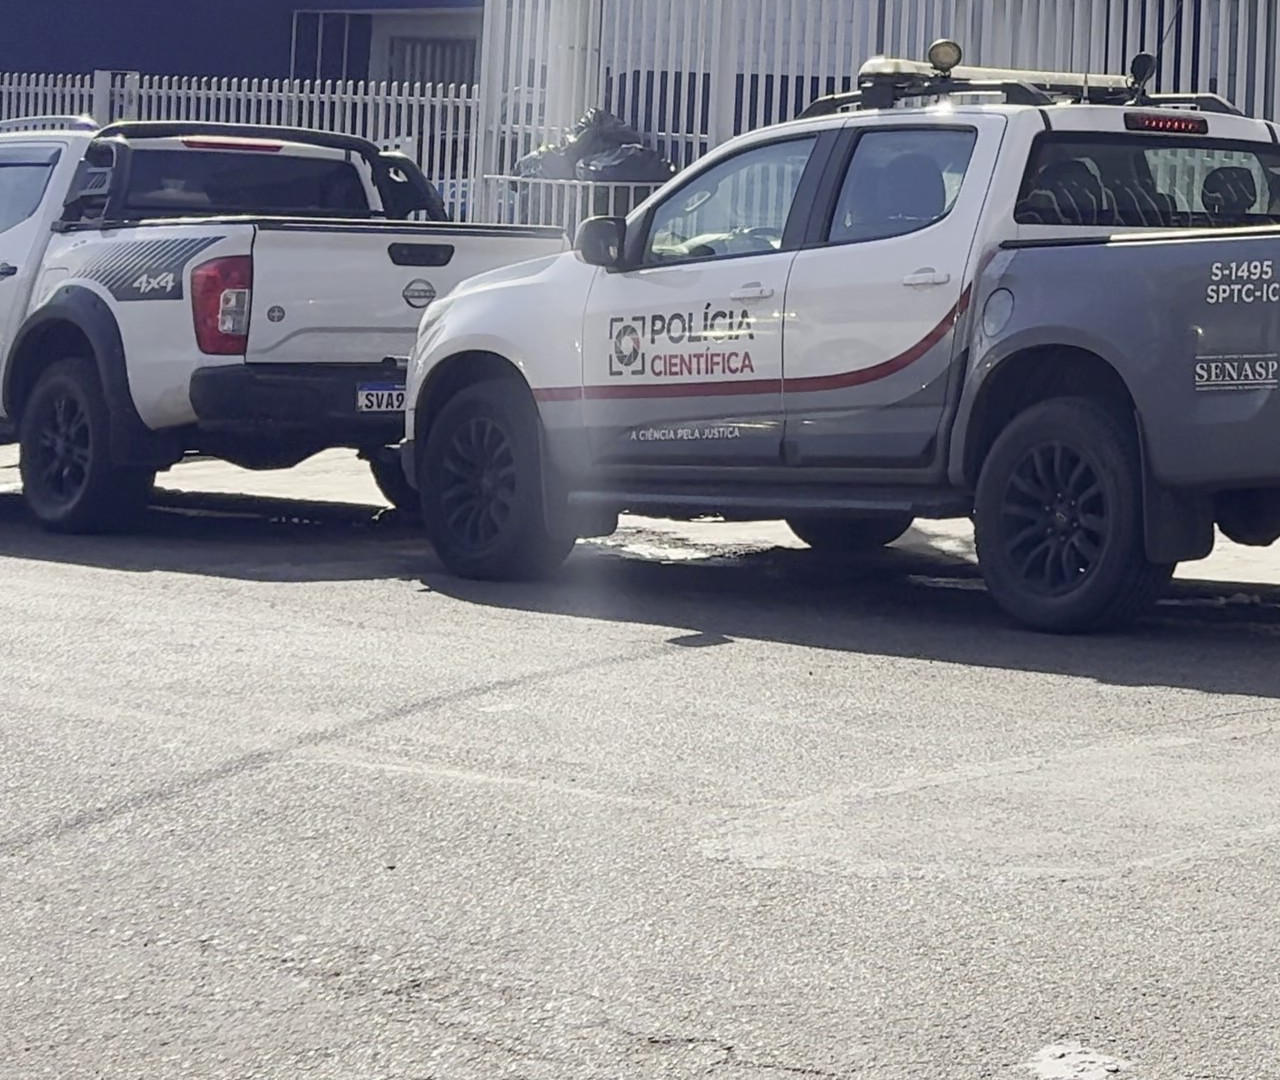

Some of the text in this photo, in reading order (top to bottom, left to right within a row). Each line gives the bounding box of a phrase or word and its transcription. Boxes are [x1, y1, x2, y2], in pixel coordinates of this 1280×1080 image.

[1211, 260, 1273, 281] S-1495
[1206, 282, 1280, 304] SPTC-IC
[650, 302, 755, 344] POLÍCIA
[650, 347, 755, 377] CIENTÍFICA
[1195, 360, 1278, 381] SENASP
[365, 392, 405, 409] SVA9
[630, 430, 638, 440] A
[638, 427, 675, 440] CIÊNCIA
[677, 428, 700, 440] PELA
